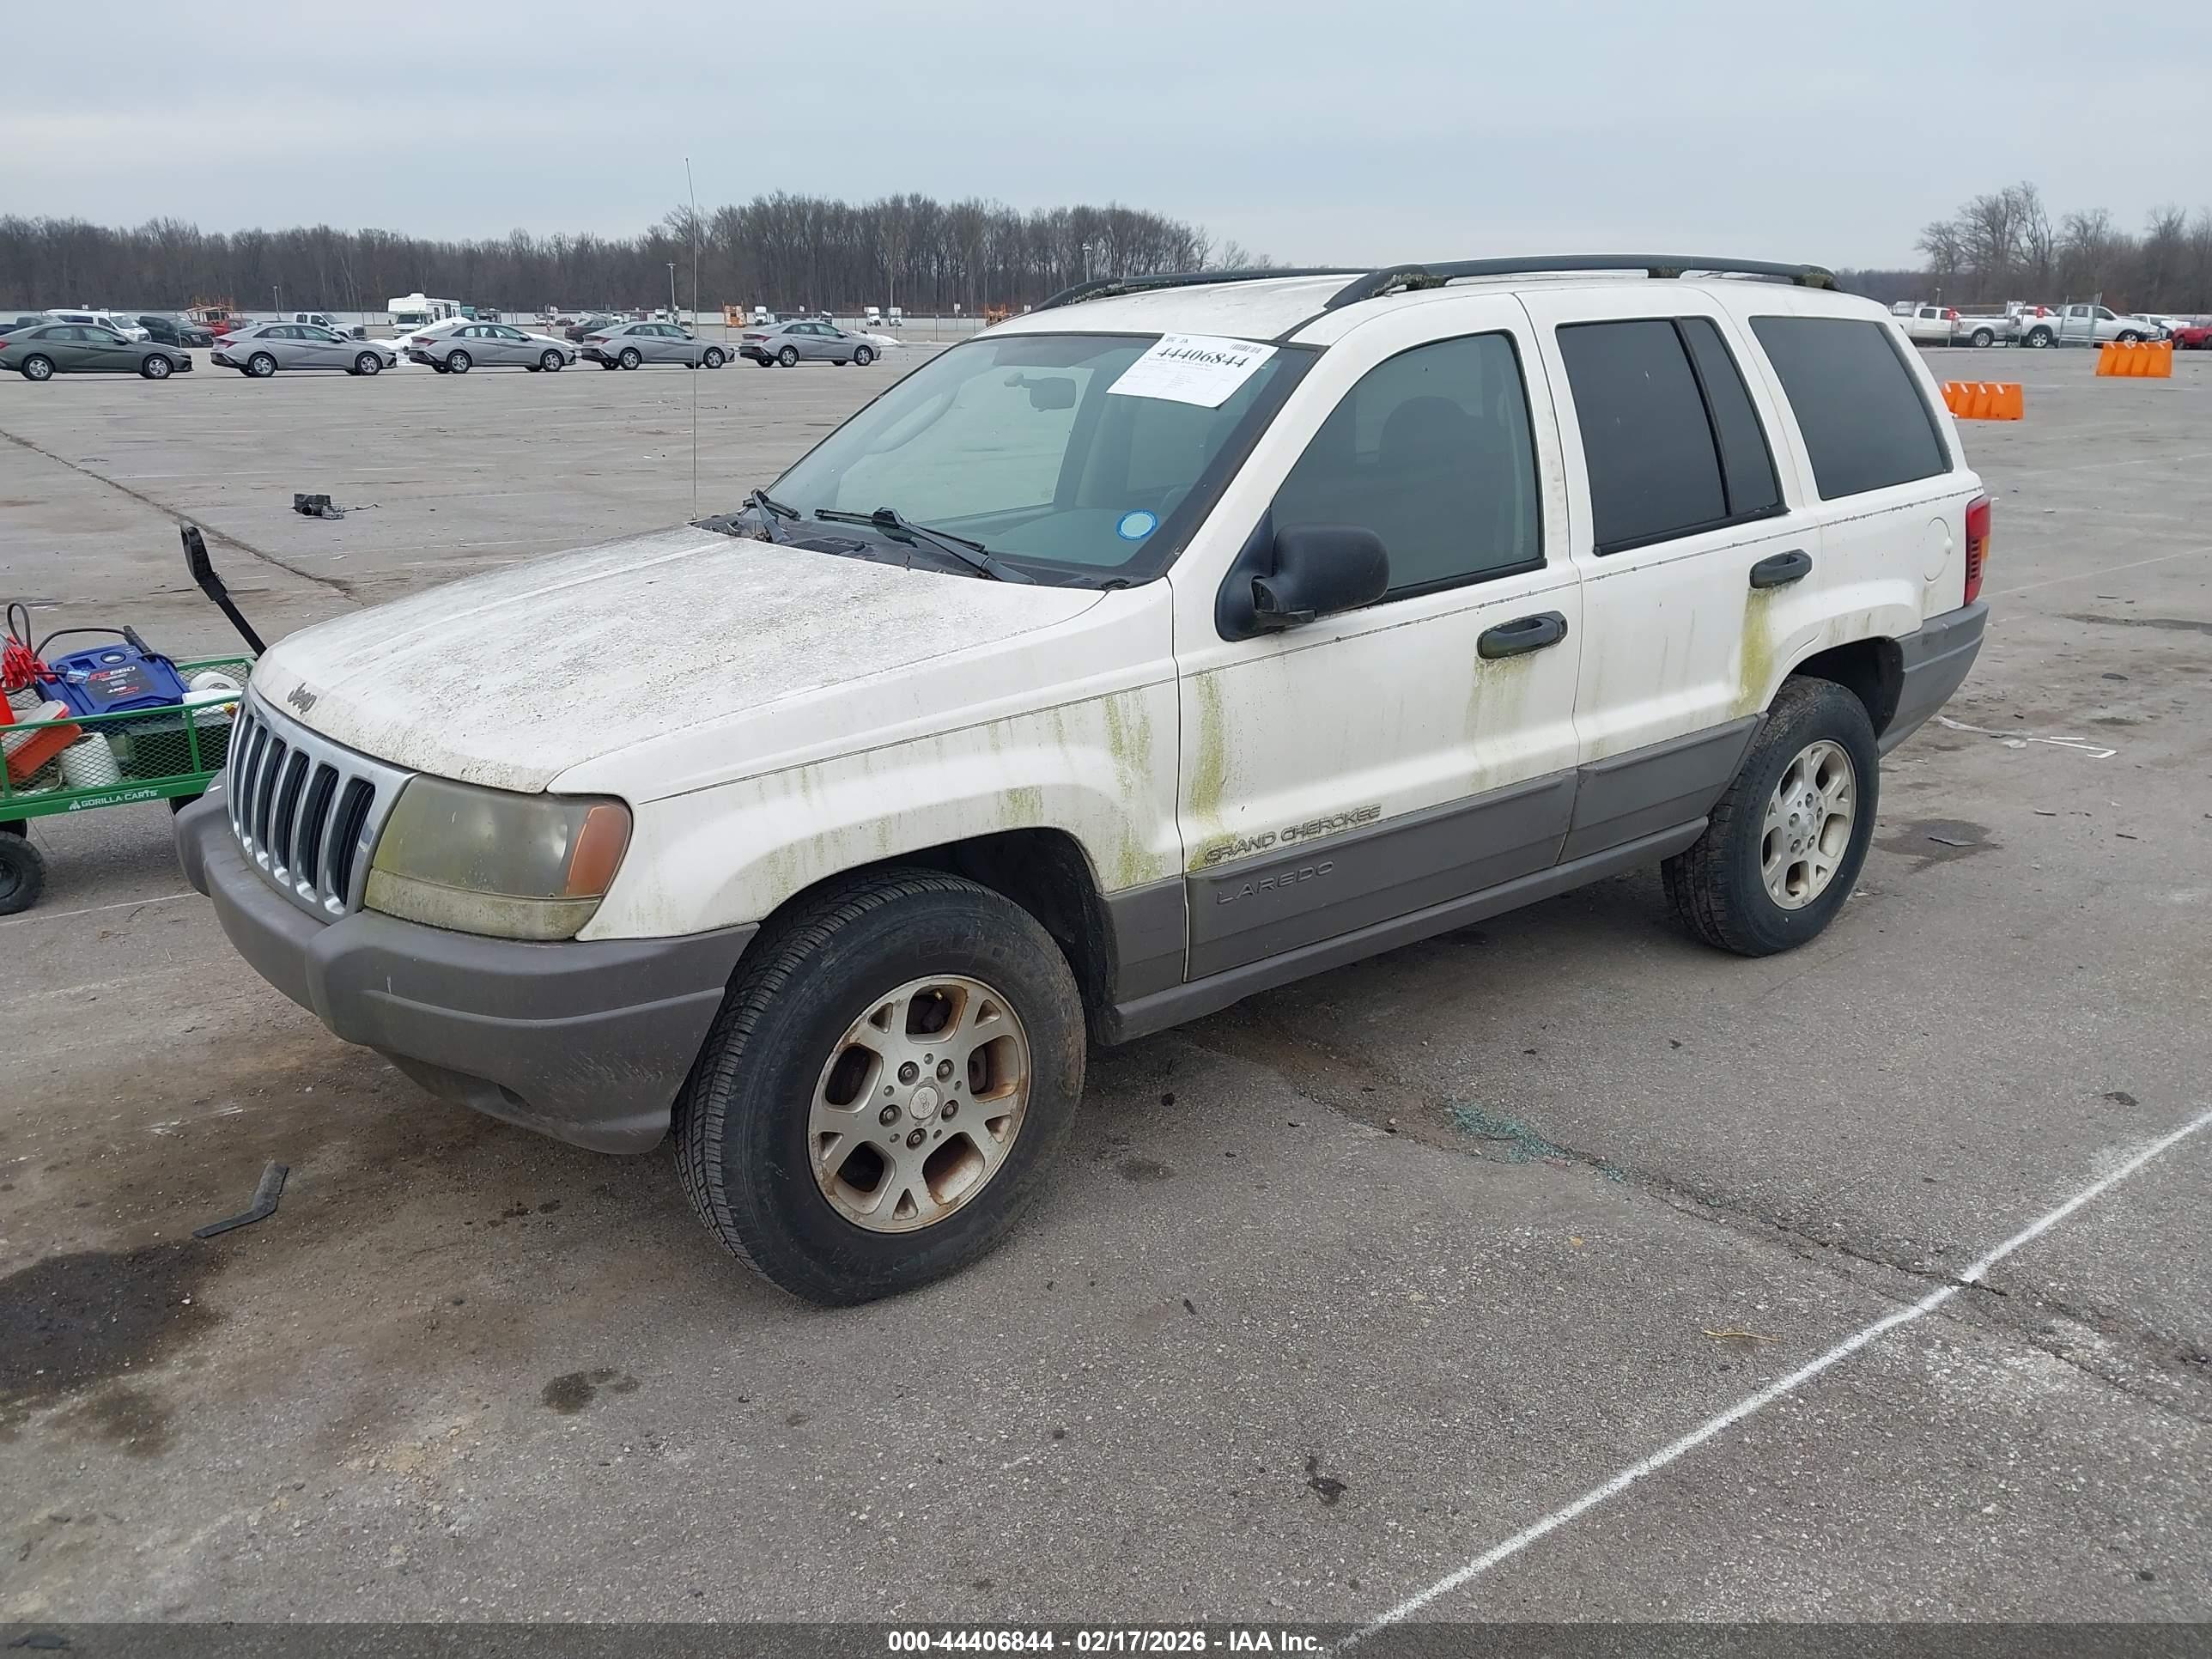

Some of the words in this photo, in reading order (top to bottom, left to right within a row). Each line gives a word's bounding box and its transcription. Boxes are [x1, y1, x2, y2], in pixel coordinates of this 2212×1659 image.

[1157, 347, 1250, 368] 44406844
[81, 795, 123, 807] GORILLA
[124, 788, 159, 801] CARTS
[1204, 830, 1277, 864] GRAND
[1280, 803, 1382, 842] CHEROKEE
[1215, 860, 1334, 905] LAREDO
